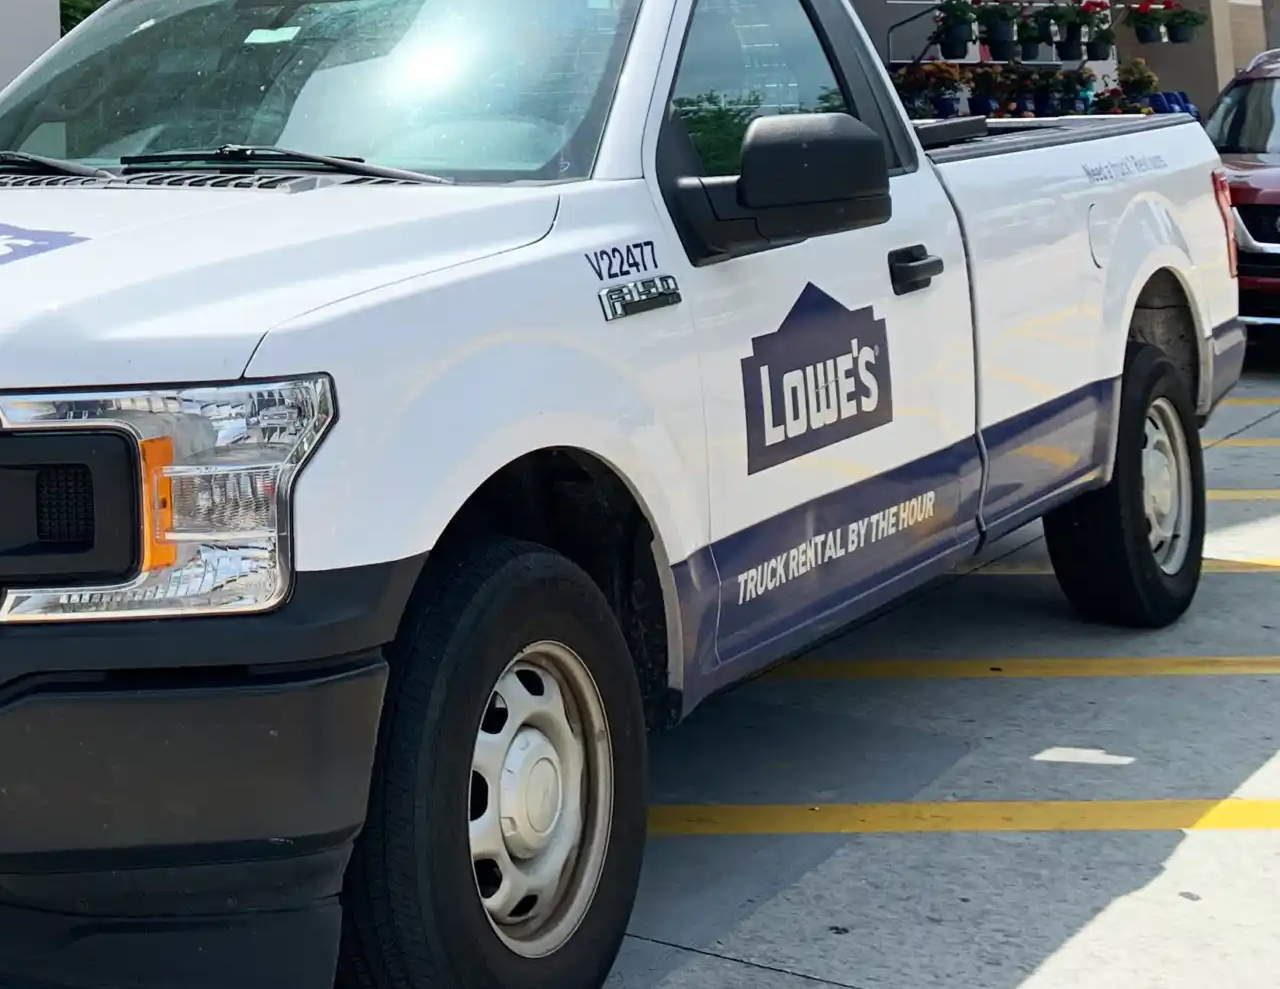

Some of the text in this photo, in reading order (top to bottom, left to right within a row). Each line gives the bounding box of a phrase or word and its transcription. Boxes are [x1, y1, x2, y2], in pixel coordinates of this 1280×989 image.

[584, 241, 658, 281] V22477
[760, 338, 879, 447] LOWE'S
[737, 491, 936, 606] TRUCK RENTAL BY THE HOUR
